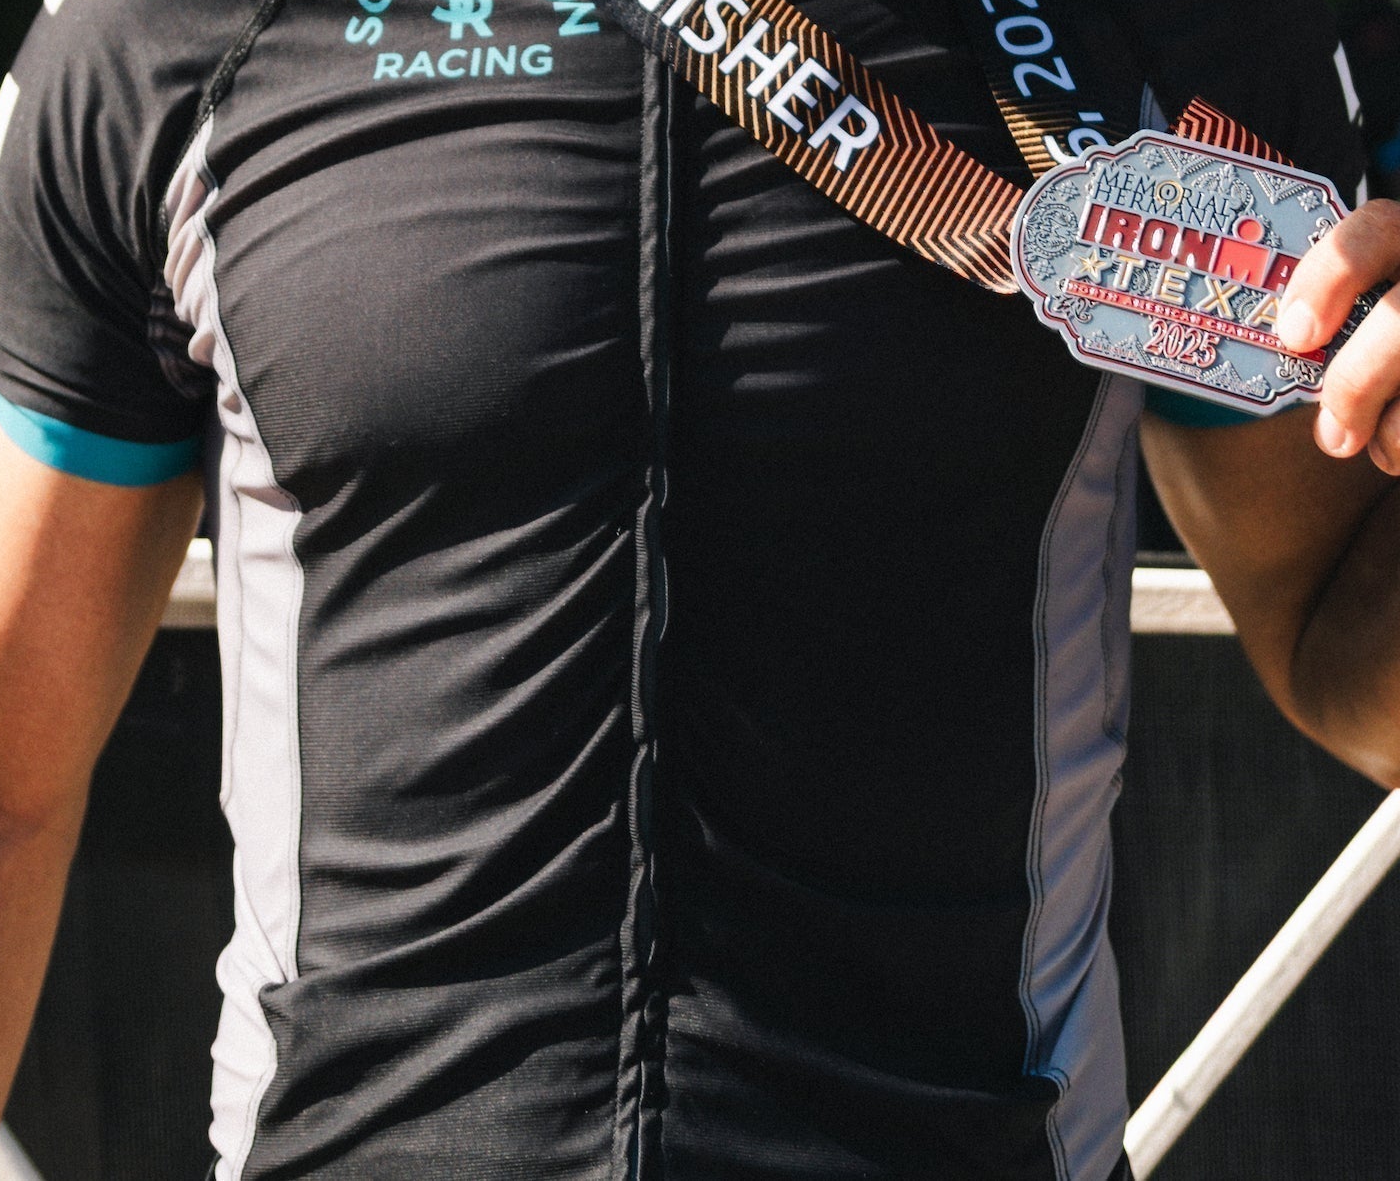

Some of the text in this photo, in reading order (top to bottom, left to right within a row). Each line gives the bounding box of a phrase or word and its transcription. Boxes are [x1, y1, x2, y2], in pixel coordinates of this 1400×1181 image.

[373, 44, 554, 80] RACING
[1094, 184, 1231, 234] HERMANN
[1099, 168, 1234, 217] MEMORIAL
[1080, 204, 1303, 295] IRONMA
[1067, 281, 1119, 302] NORTH
[1125, 296, 1205, 325] AMERICAN
[1110, 251, 1282, 328] TEXA
[1143, 318, 1221, 369] 2025
